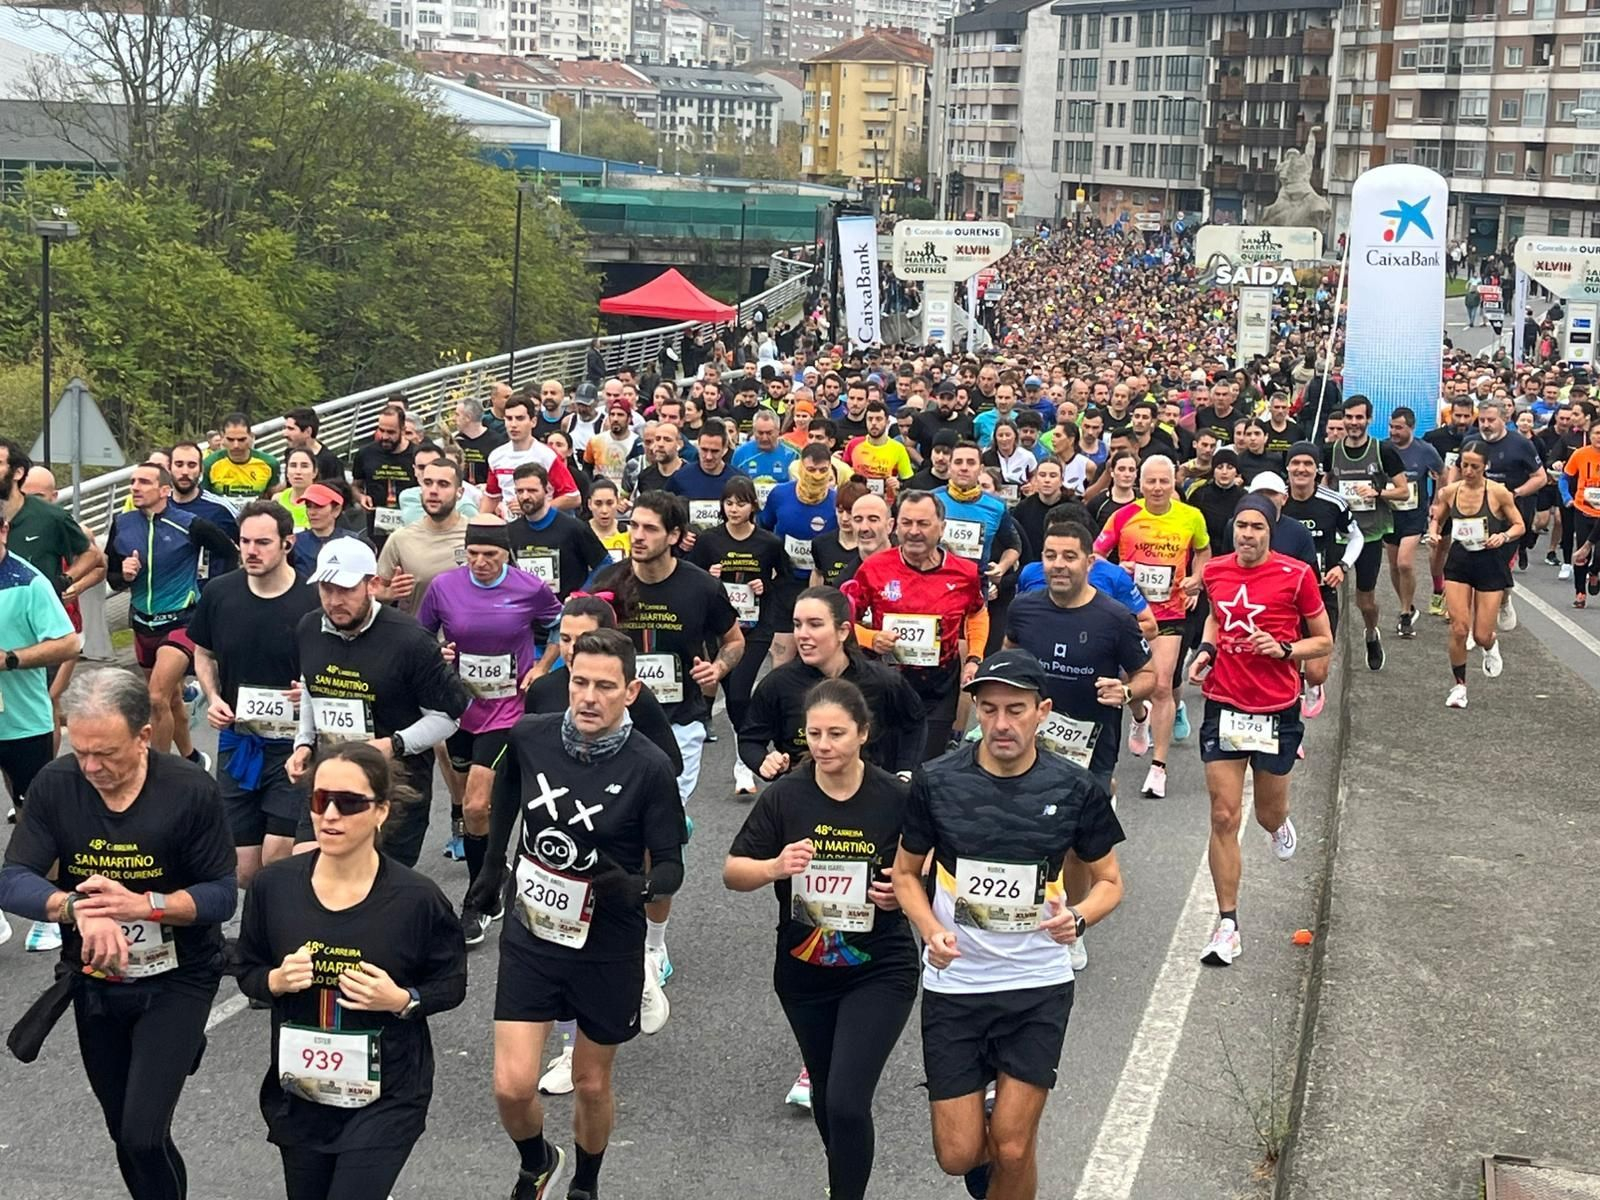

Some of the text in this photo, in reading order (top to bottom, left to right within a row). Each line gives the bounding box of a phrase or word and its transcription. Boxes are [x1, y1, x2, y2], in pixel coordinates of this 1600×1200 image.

[954, 228, 1001, 236] OURENSE
[955, 245, 991, 255] XLVIII
[1366, 250, 1440, 266] CaixaBank
[1216, 262, 1298, 285] SAÍDA
[1536, 261, 1571, 272] XLVIII
[853, 242, 874, 344] CaixaBank
[950, 528, 973, 540] 1659
[790, 544, 812, 556] 1606
[1140, 572, 1164, 584] 3152
[640, 612, 677, 622] MARTIÑO
[468, 664, 502, 678] 2168
[1052, 661, 1094, 675] Penedo
[315, 674, 368, 692] SAN MARTIÑO
[246, 700, 284, 716] 3245
[322, 710, 354, 728] 1765
[1230, 720, 1262, 732] 1578
[1046, 721, 1082, 742] 2987
[825, 840, 876, 854] MARTIÑO
[75, 854, 154, 868] SAN MARTIÑO
[68, 864, 164, 879] CONCELO DE OURENSE
[805, 874, 852, 896] 1077
[969, 876, 1020, 899] 2926
[524, 878, 570, 910] 2308
[324, 946, 361, 958] CARREIRA
[315, 960, 362, 974] MARTI
[302, 1048, 344, 1071] 939
